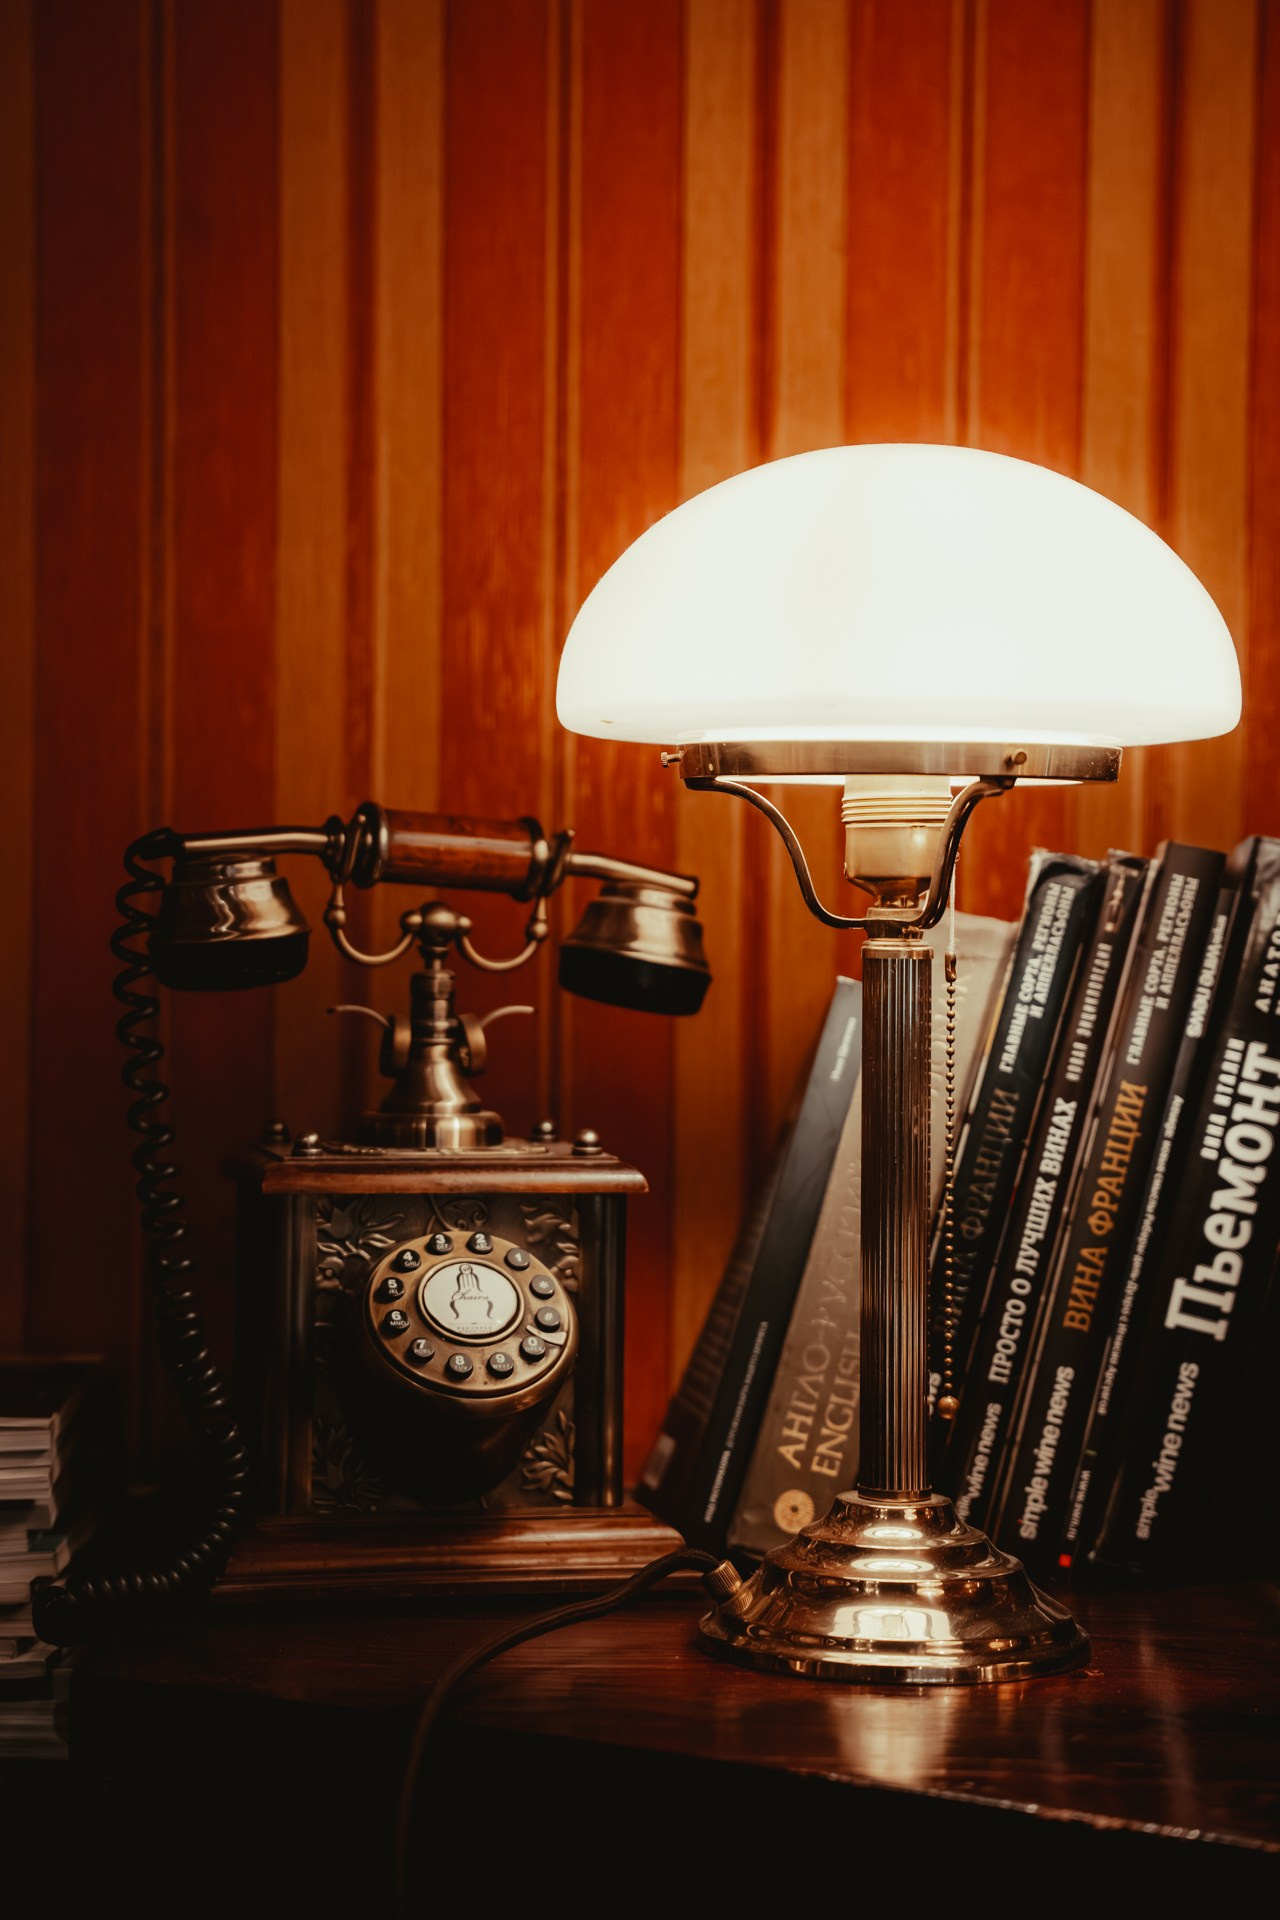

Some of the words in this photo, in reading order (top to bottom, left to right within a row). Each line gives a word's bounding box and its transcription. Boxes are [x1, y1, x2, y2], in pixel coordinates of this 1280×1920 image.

[999, 1003, 1029, 1074] ГЛАВНЫЕ
[1032, 883, 1061, 952] РЕГИОНЫ
[1126, 995, 1155, 1066] ГЛАВНЫЕ
[1156, 873, 1185, 943] РЕГИОНЫ
[1213, 1038, 1246, 1107] ИТАЛИИ
[1039, 1097, 1077, 1176] ВИНАХ
[1200, 1113, 1227, 1161] ВИНА
[960, 1087, 1019, 1240] ФРАНЦИИ
[1015, 1177, 1057, 1276] ЛУЧШИХ
[1063, 1246, 1108, 1332] ВИНА
[1087, 1080, 1148, 1236] ФРАНЦИИ
[403, 1251, 413, 1261] 4
[435, 1234, 445, 1244] 3
[475, 1233, 485, 1243] 2
[514, 1252, 522, 1262] 1
[388, 1279, 398, 1288] 5
[1011, 1278, 1031, 1296] О
[391, 1311, 401, 1320] 6
[416, 1339, 426, 1349] 7
[455, 1355, 465, 1365] 8
[495, 1354, 505, 1363] 9
[528, 1337, 538, 1346] 0
[987, 1299, 1026, 1384] ПРОСТО
[1046, 1366, 1075, 1425] news
[977, 1402, 1002, 1454] news
[1034, 1424, 1061, 1476] wine
[1152, 1432, 1182, 1492] wine
[1168, 1361, 1199, 1431] news
[967, 1453, 990, 1499] wine
